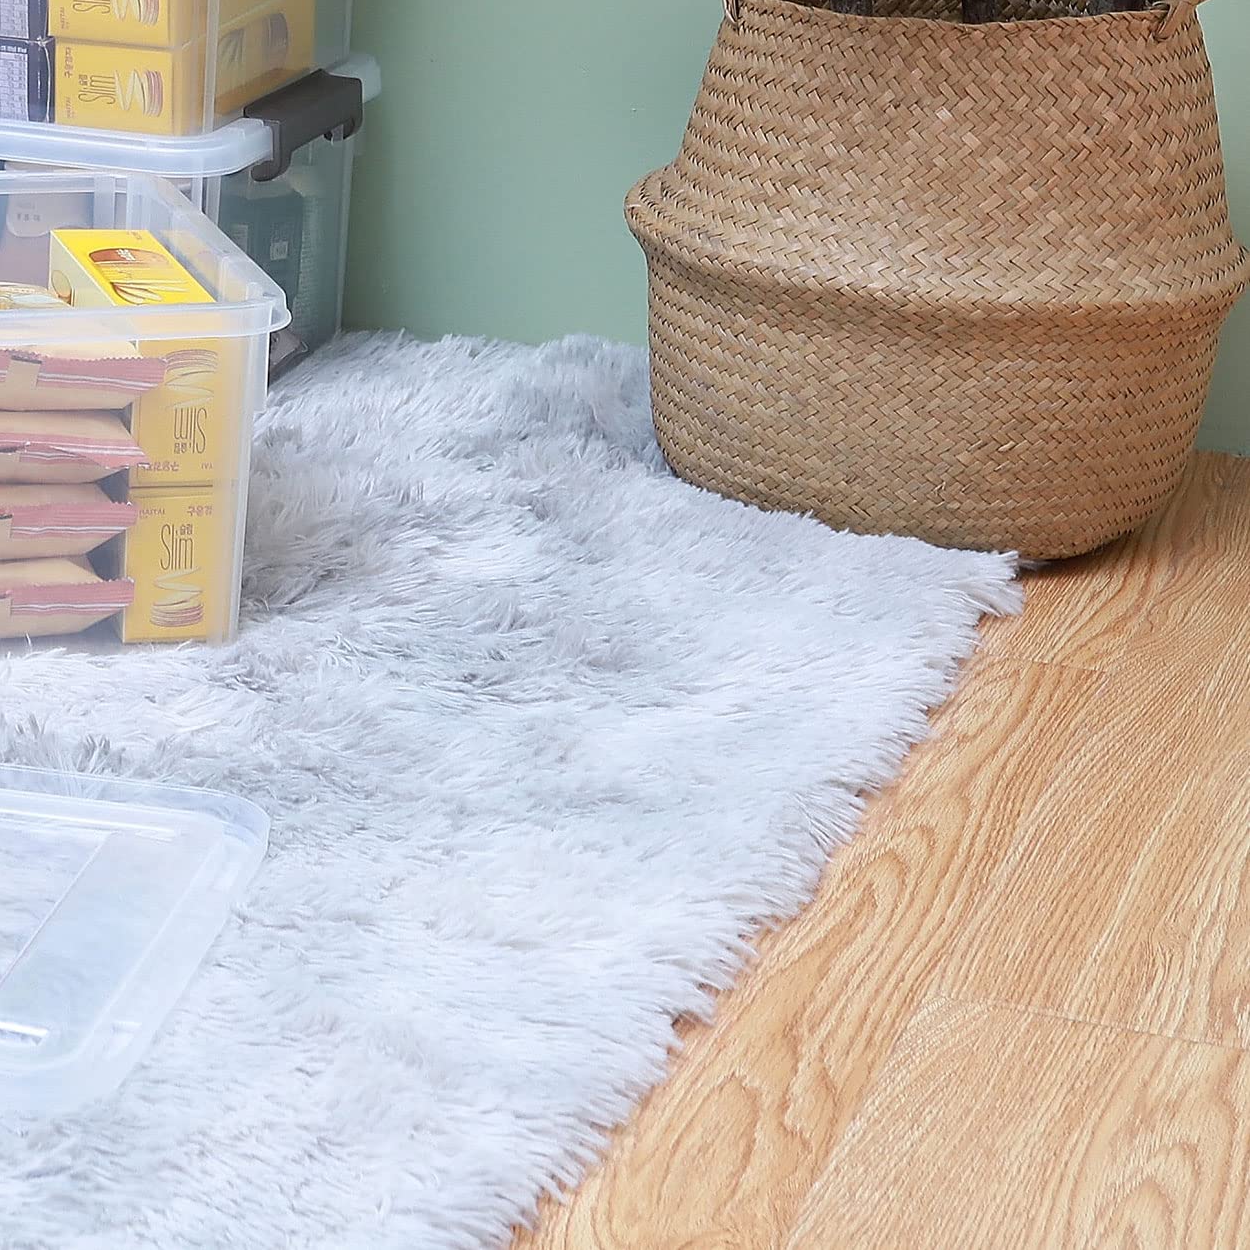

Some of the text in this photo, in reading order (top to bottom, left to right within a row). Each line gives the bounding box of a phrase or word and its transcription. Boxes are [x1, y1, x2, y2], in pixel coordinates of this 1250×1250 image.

[77, 75, 116, 105] Slim
[173, 406, 208, 454] Slim
[160, 523, 194, 571] Slim
